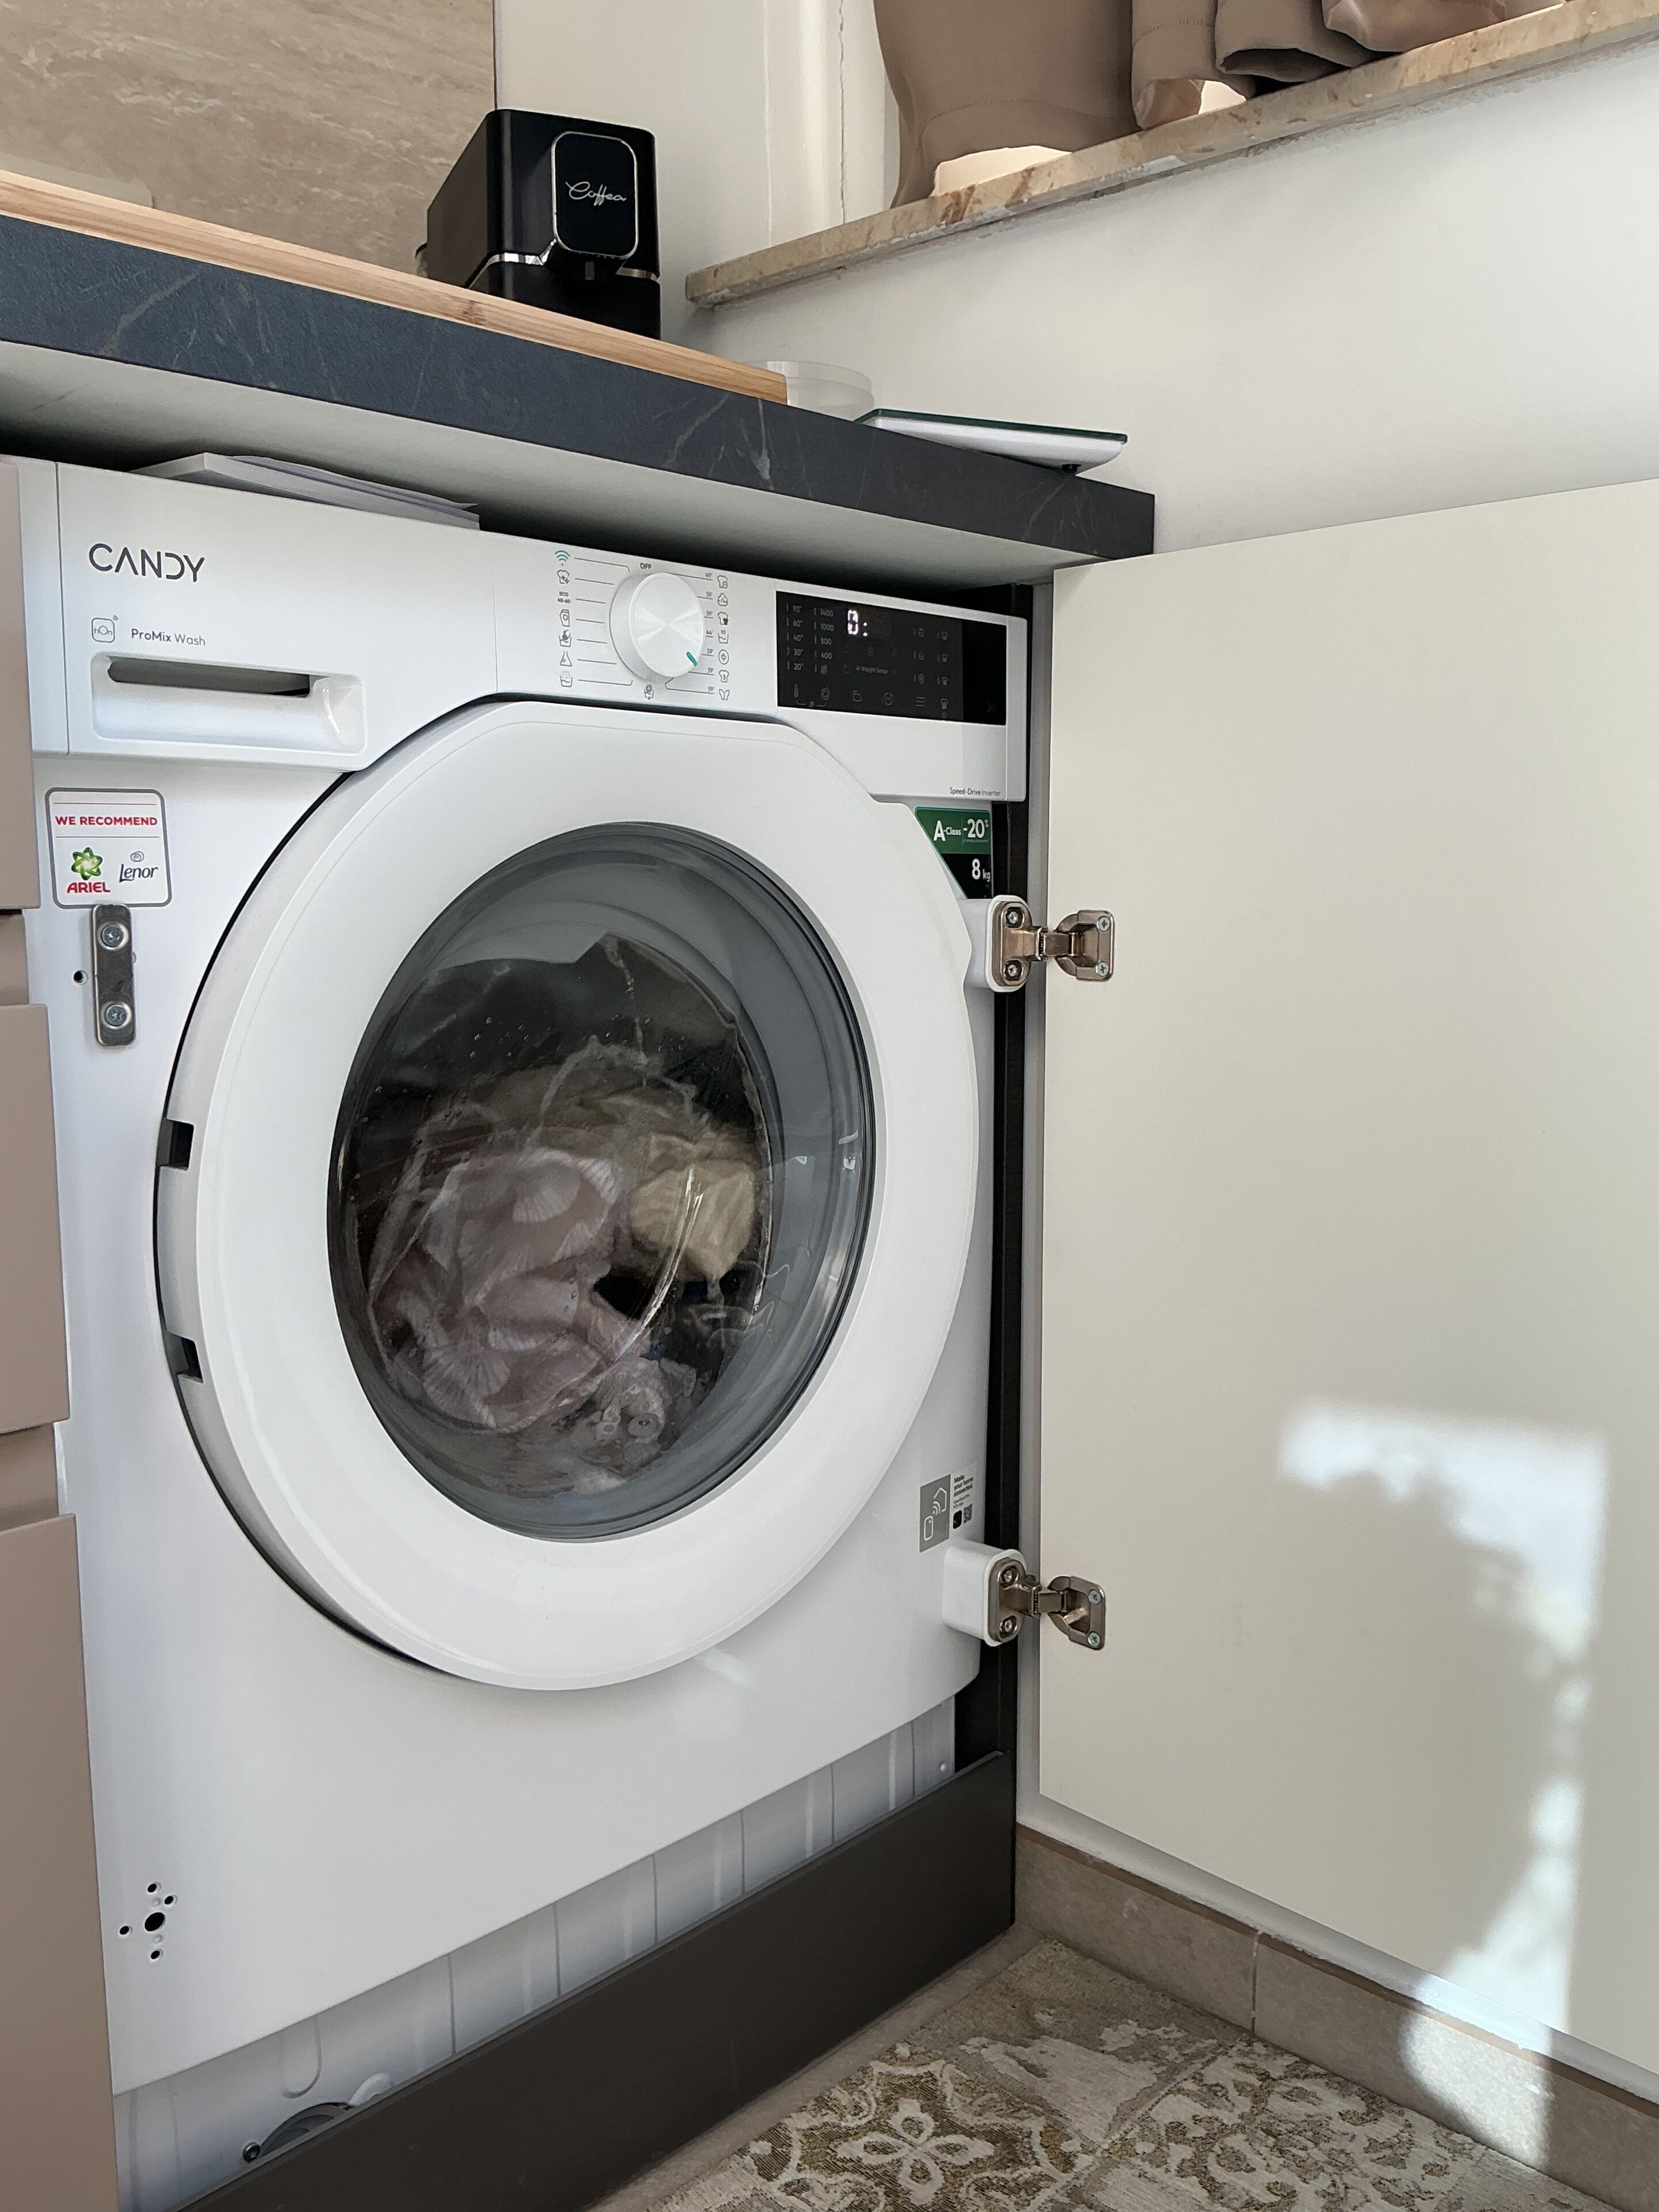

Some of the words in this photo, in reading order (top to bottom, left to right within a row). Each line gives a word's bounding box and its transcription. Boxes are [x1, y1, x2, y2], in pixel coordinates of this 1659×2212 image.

[565, 181, 627, 206] Coffea
[88, 543, 206, 583] CANDY
[640, 562, 652, 570] OFF
[820, 608, 834, 618] 1400
[820, 622, 835, 632] 1000
[131, 628, 172, 643] ProMix
[174, 632, 206, 646] Wash
[820, 652, 833, 660] 400
[982, 789, 1001, 797] Inverter
[55, 816, 76, 825] WE
[79, 816, 158, 826] RECOMMEND
[933, 820, 962, 842] A-Class
[119, 863, 159, 883] Lenor
[972, 858, 981, 880] 8
[983, 869, 991, 882] kg
[66, 881, 111, 894] ARIEL
